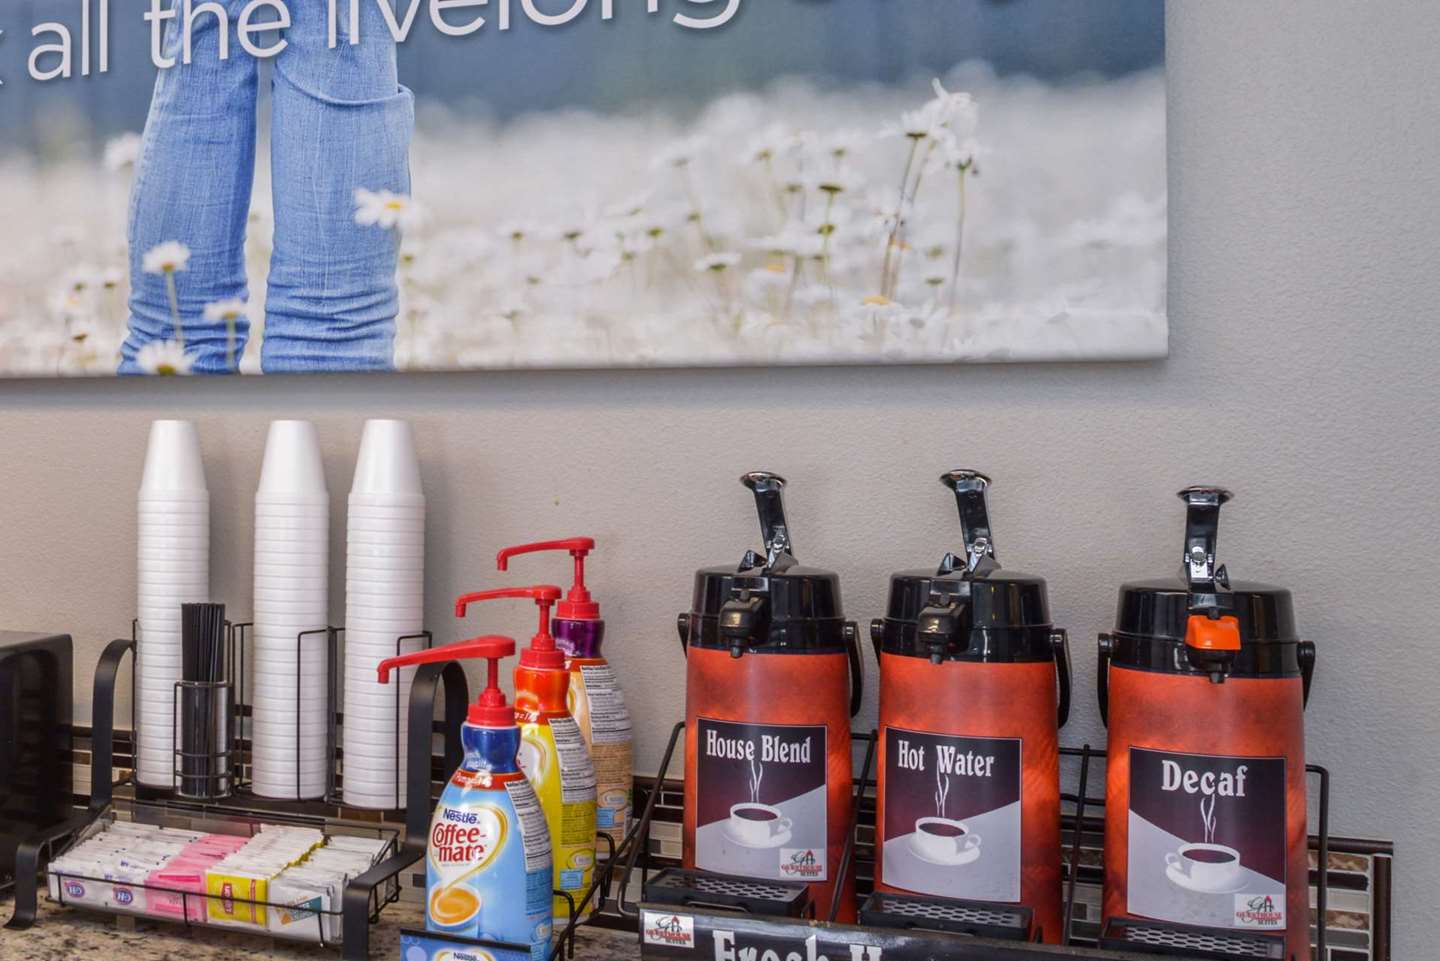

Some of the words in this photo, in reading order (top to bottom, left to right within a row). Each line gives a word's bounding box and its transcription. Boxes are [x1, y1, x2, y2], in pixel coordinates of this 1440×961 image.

[26, 0, 111, 81] all
[144, 0, 292, 69] the
[705, 729, 755, 761] House
[761, 734, 812, 764] Blend
[897, 739, 926, 772] Hot
[935, 745, 995, 778] Water
[1160, 759, 1249, 798] Decaf
[438, 844, 485, 862] mate
